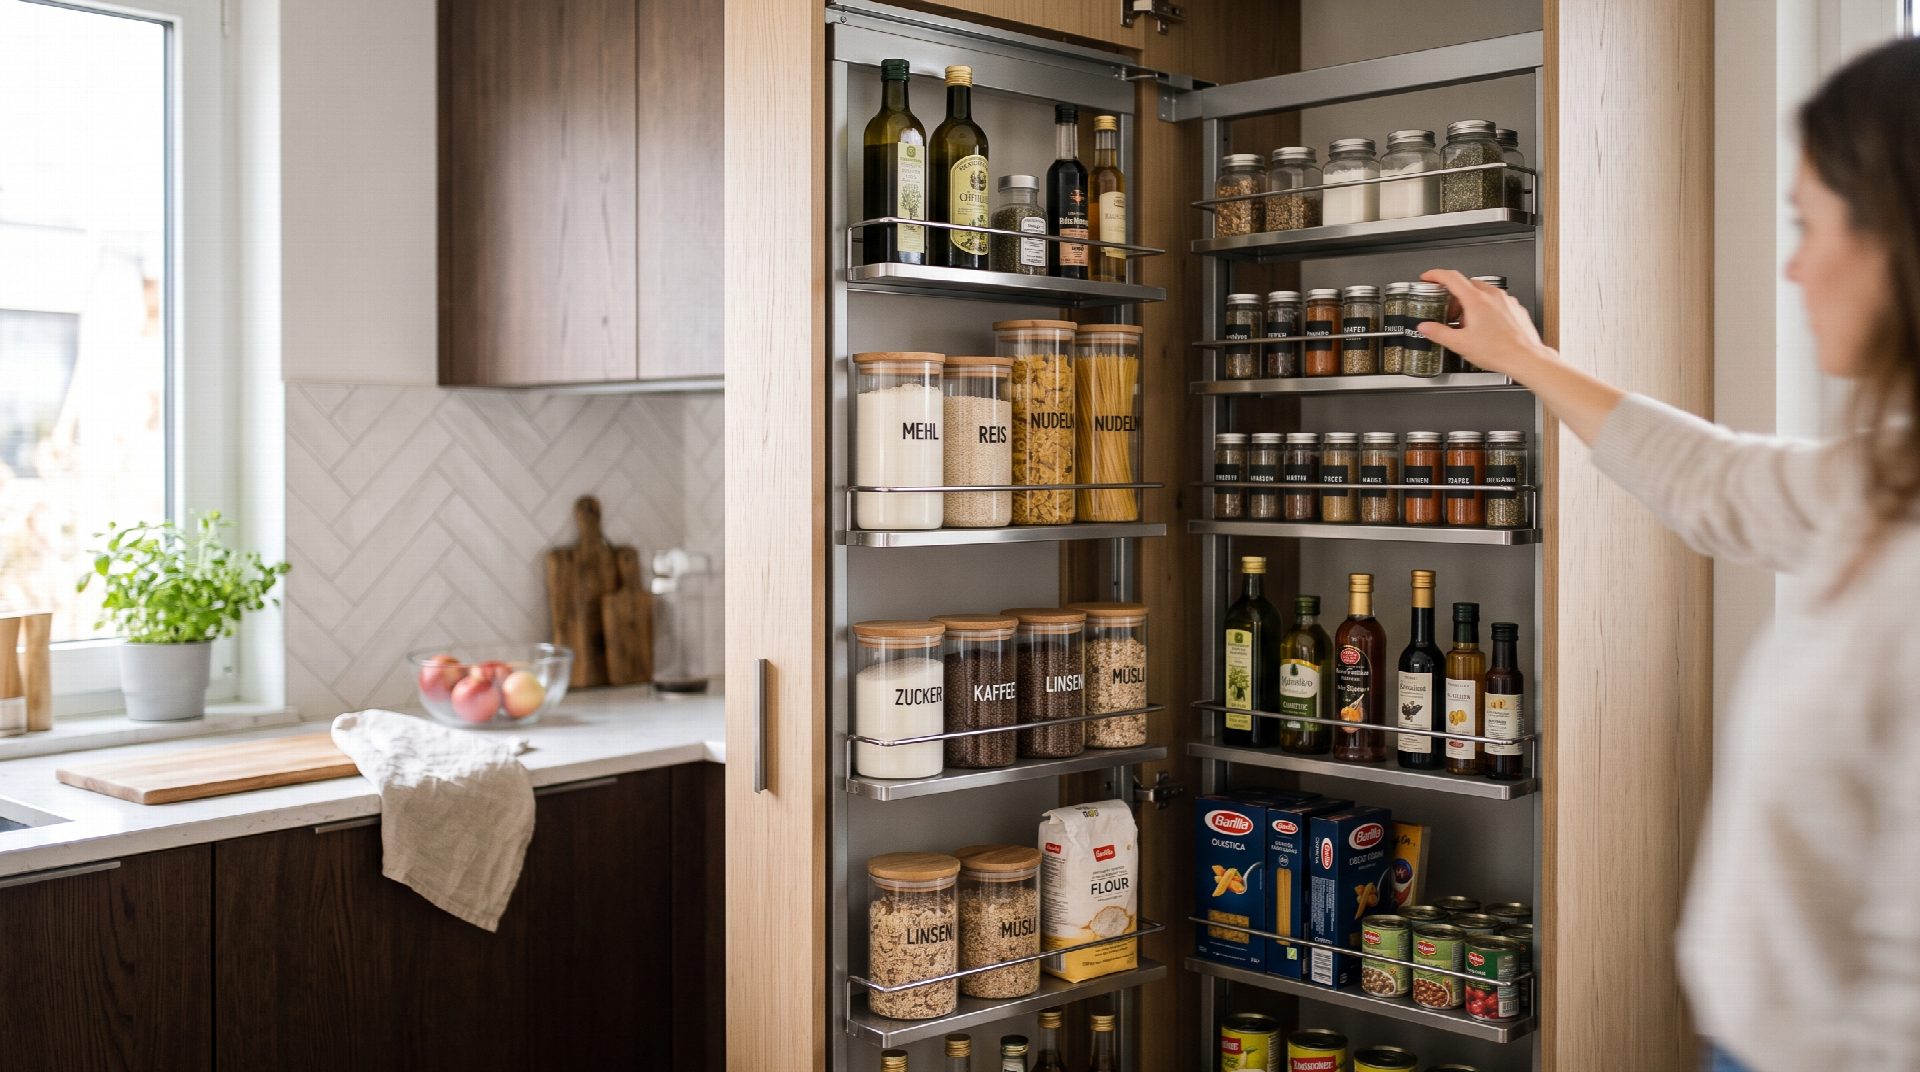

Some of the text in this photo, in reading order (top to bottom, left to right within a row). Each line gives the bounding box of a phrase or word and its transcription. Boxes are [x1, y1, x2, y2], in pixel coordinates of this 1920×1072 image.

[902, 422, 939, 440] MEHL
[979, 426, 1007, 443] REIS
[1046, 674, 1084, 692] LINSEN
[1112, 665, 1145, 684] MÜSLI
[895, 686, 942, 705] ZUCKER
[974, 682, 1016, 702] KAFFEE
[1215, 815, 1249, 830] Barilla
[1356, 827, 1381, 844] Barilla
[1091, 877, 1129, 895] FLOUR
[906, 923, 953, 945] LINSEN
[1001, 916, 1037, 938] MÜSLI
